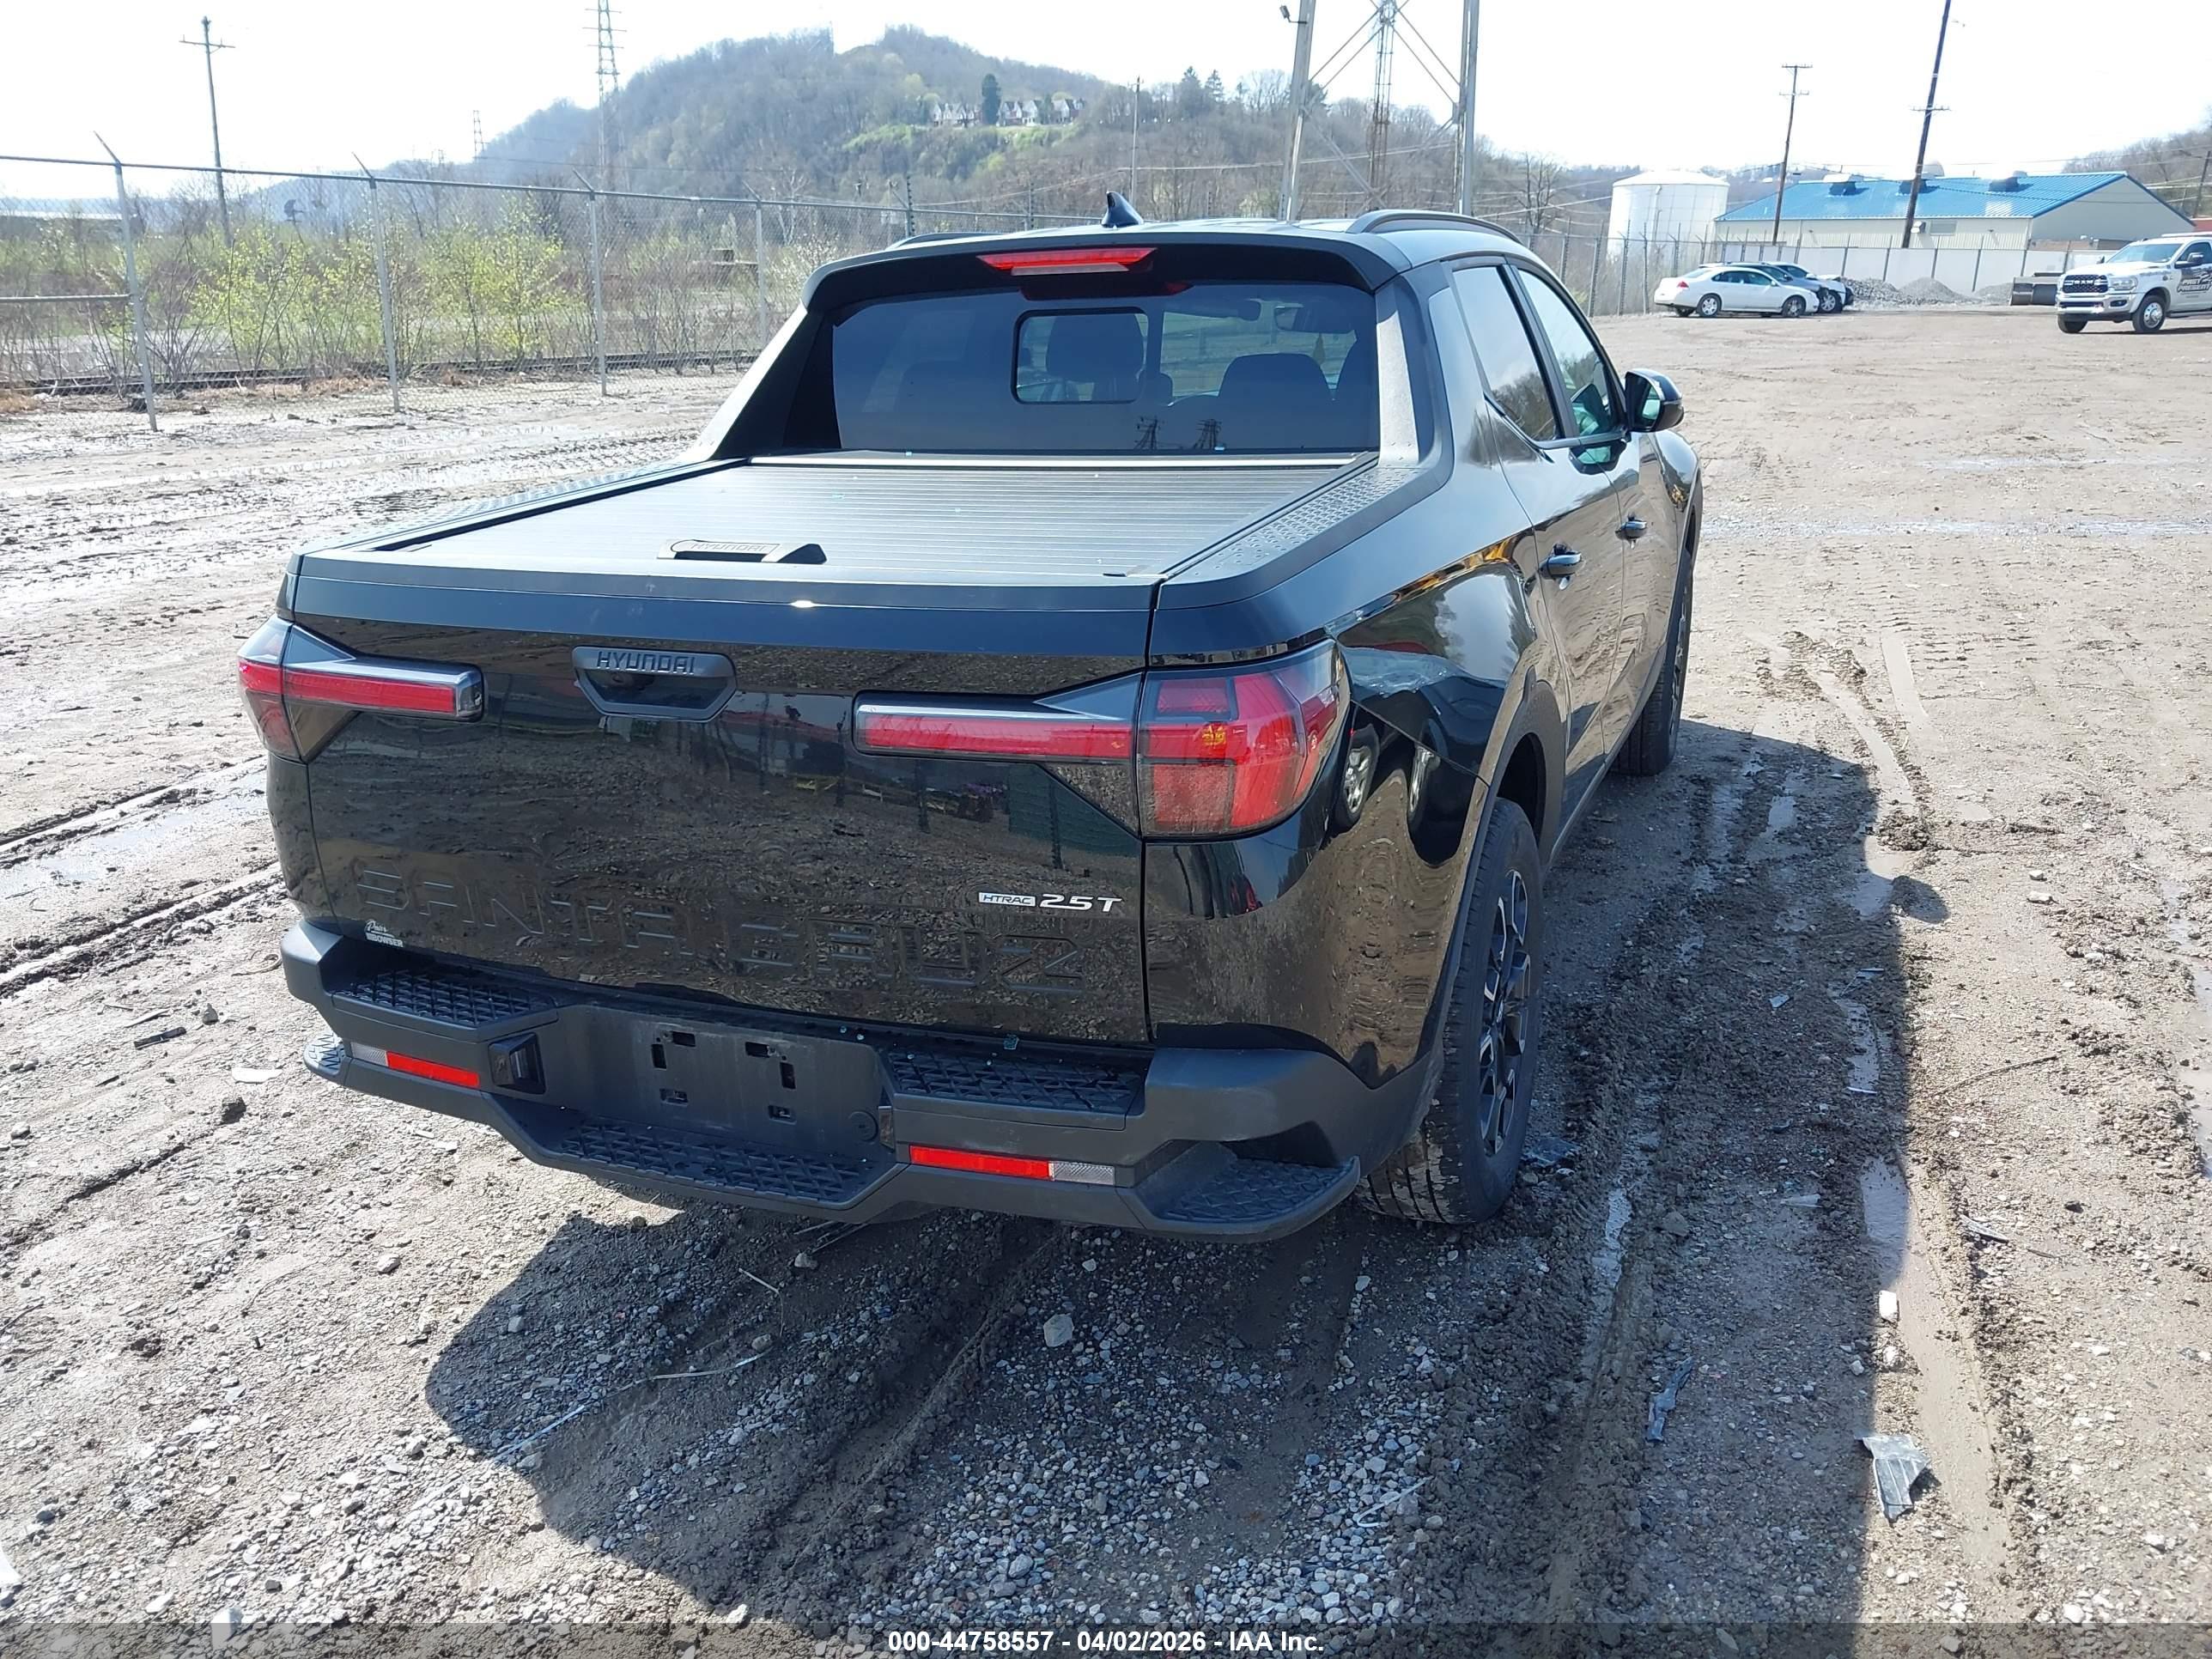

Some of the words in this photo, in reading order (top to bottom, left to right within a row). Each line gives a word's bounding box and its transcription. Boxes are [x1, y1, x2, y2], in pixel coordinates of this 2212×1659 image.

[690, 542, 768, 552] HYUNDAI
[596, 650, 696, 676] HYUNDAI
[982, 894, 1032, 905] HTRAC
